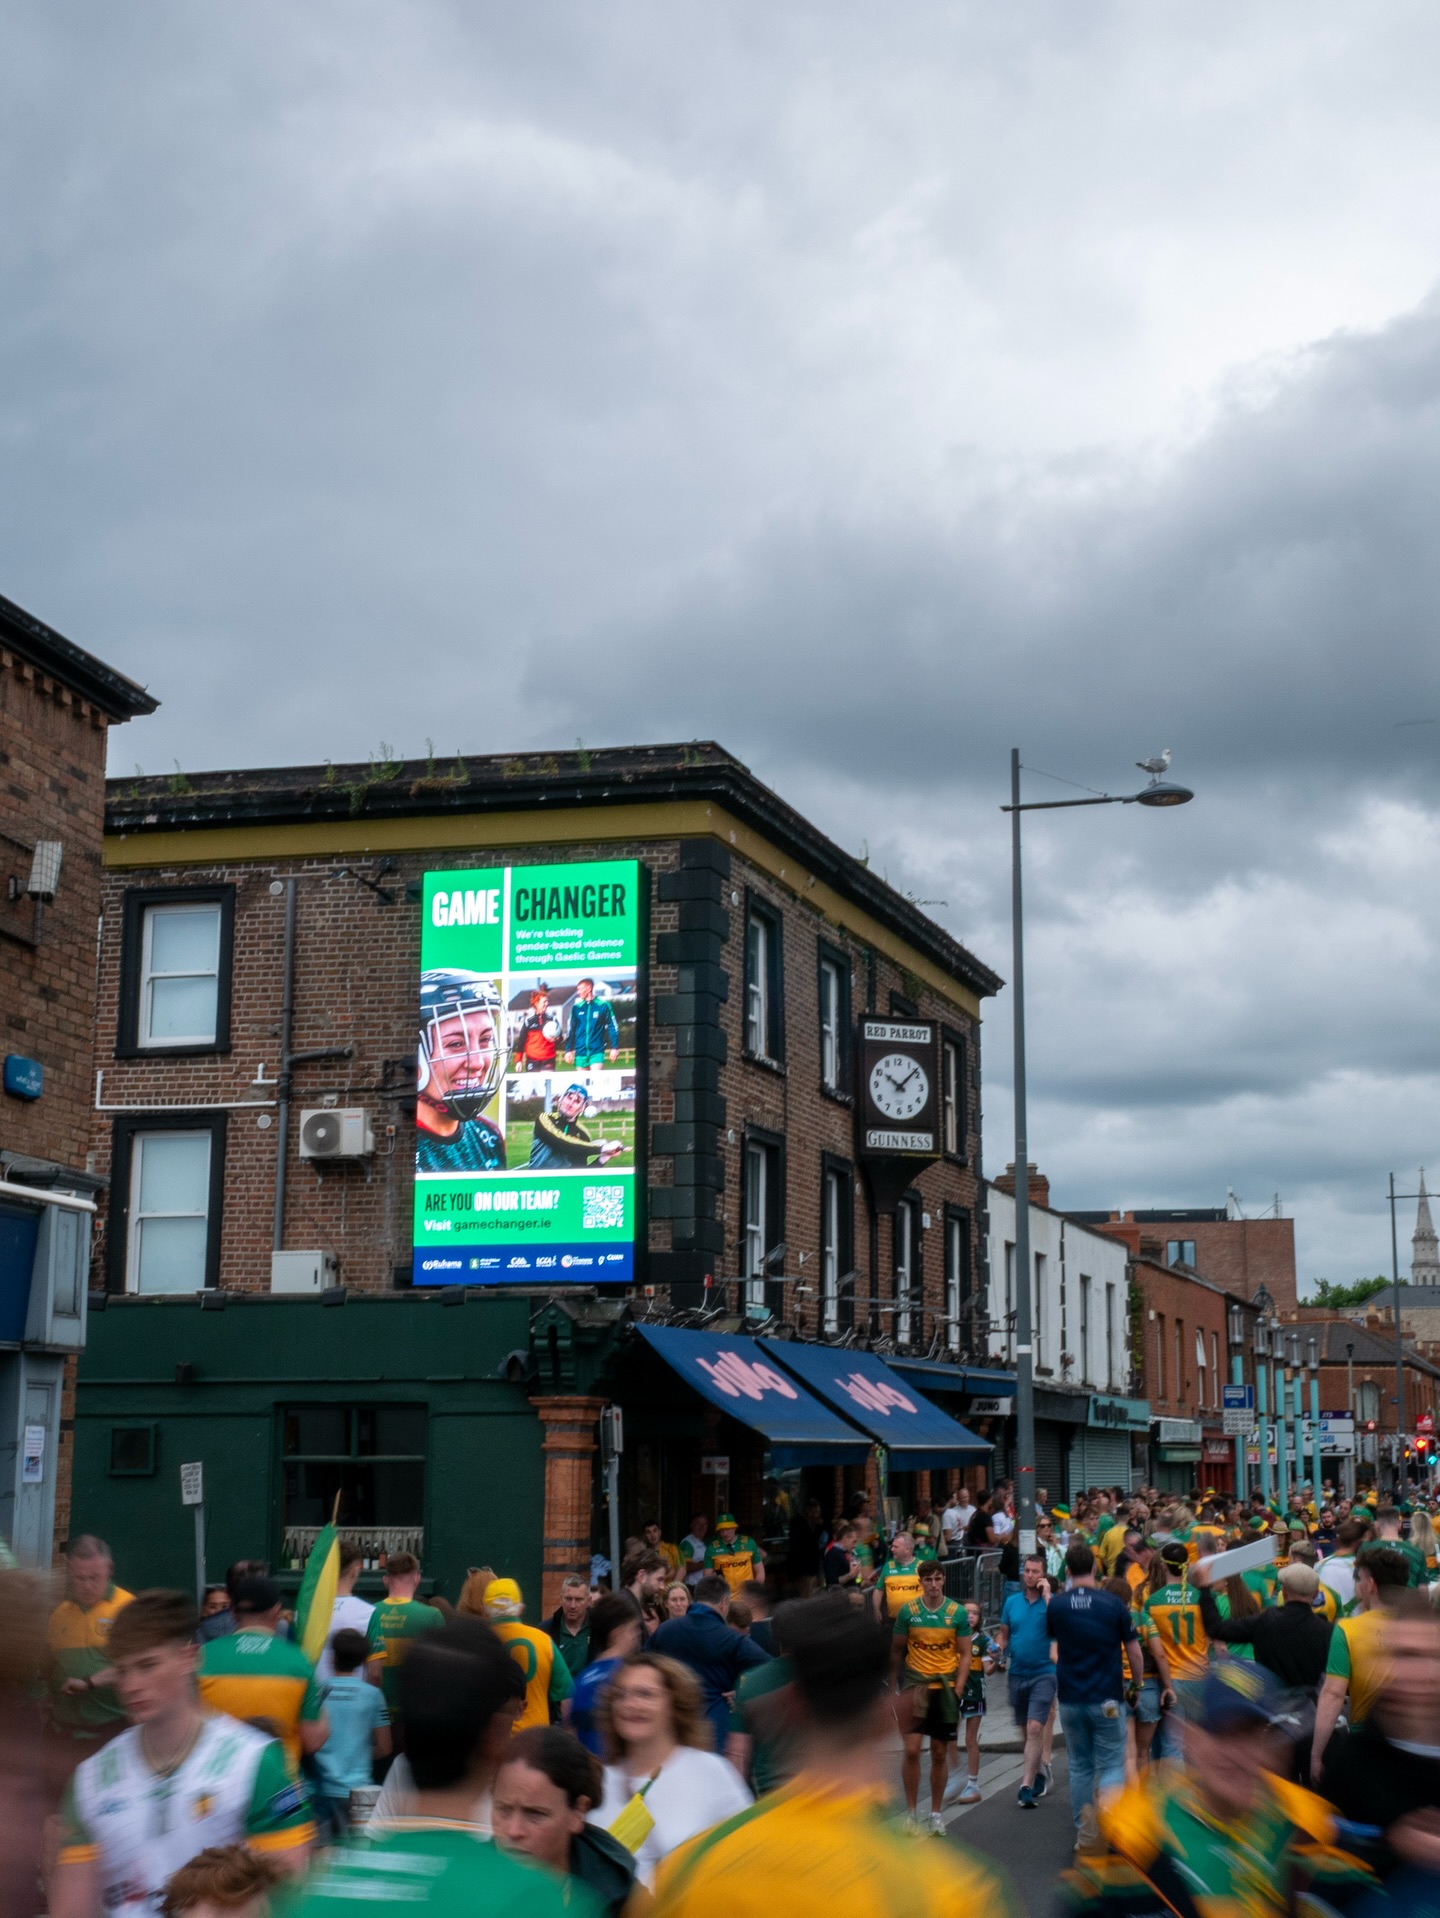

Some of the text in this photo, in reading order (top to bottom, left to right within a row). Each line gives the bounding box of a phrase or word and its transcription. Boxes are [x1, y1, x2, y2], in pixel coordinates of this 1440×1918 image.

[432, 884, 626, 927] GAME CHANGER
[516, 928, 583, 940] We're tackling
[516, 938, 624, 953] gender-based violence
[515, 950, 622, 964] through Gaelic Games
[867, 1026, 928, 1040] RED PARROT
[893, 1058, 903, 1066] 12
[868, 1130, 931, 1149] GUINNESS
[425, 1190, 560, 1212] ARE YOU ON OUR TEAM?
[424, 1217, 552, 1232] Visit gamechanger.ie
[976, 1401, 1000, 1411] JUNO
[1168, 1611, 1194, 1645] 11
